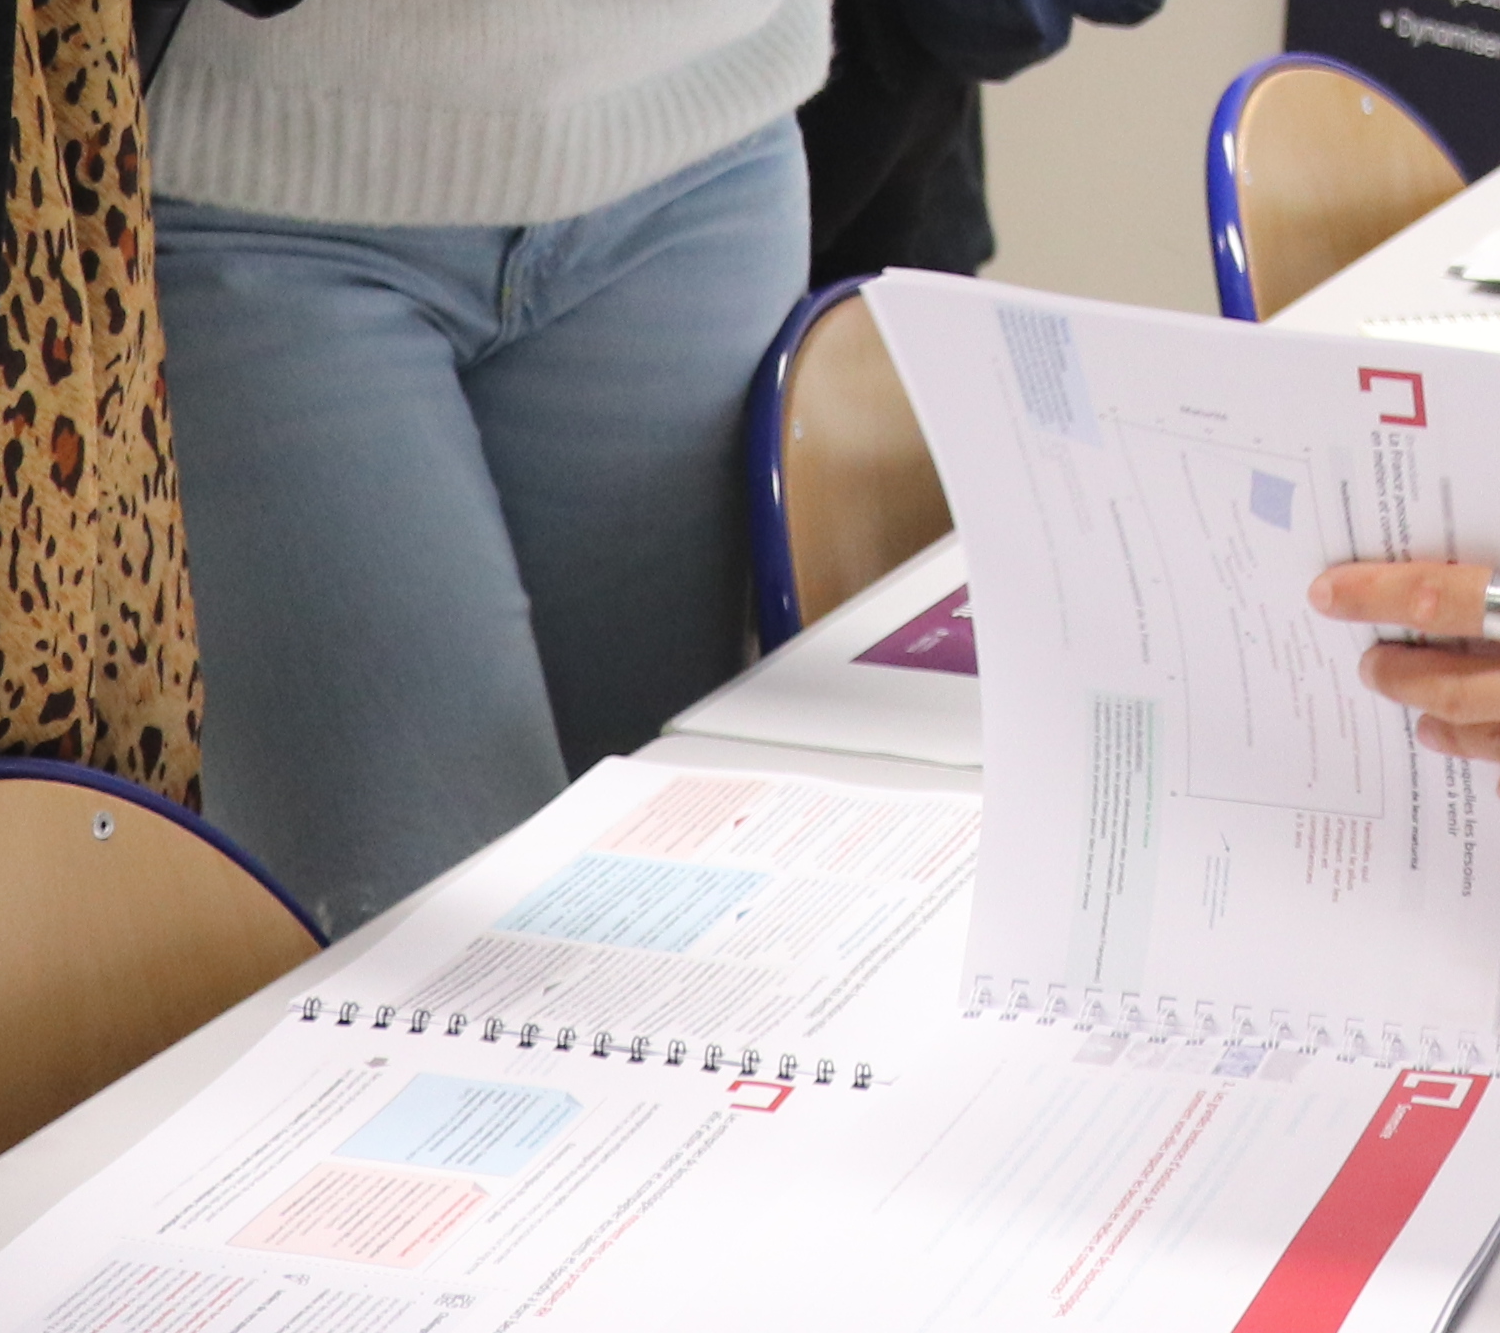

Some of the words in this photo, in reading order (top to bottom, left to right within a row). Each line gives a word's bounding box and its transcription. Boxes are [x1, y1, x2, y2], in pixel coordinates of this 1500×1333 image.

[1459, 759, 1474, 814] esquelles
[1446, 803, 1458, 836] venir
[1463, 818, 1476, 837] les
[1460, 842, 1477, 897] besoins
